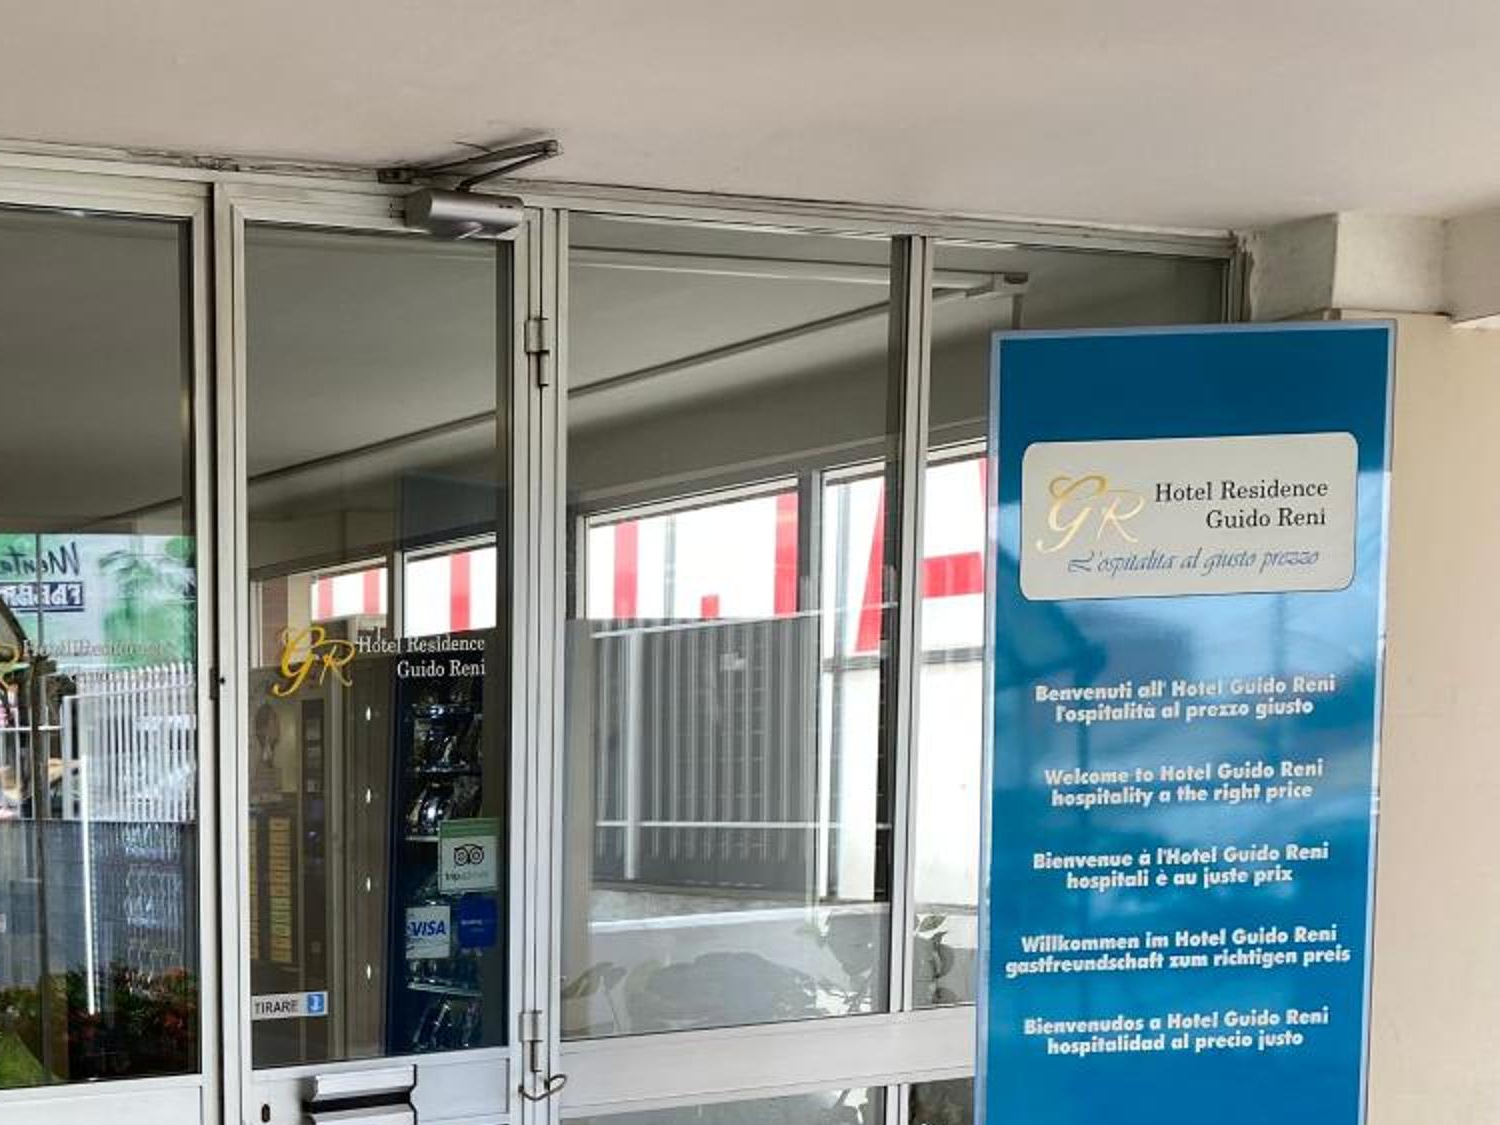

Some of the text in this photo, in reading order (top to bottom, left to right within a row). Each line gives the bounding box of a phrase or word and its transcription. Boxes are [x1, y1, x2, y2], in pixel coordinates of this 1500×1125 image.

[1155, 480, 1328, 503] Hotel Residence
[1205, 507, 1327, 530] Guido Reni
[1179, 547, 1202, 569] al
[1203, 550, 1257, 576] giusto
[1259, 551, 1319, 574] prezzo
[358, 636, 485, 653] Hotel Residence
[397, 658, 485, 677] Guido Reni
[1035, 680, 1132, 702] Benvenuti
[1171, 679, 1222, 697] Hotel
[1231, 677, 1286, 695] Guido
[1293, 674, 1336, 693] Reni
[1161, 700, 1180, 719] al
[1186, 703, 1249, 722] prezzo
[1255, 698, 1314, 719] giusto
[1044, 758, 1324, 786] Welcome to Hotel Guido Reni
[1051, 782, 1313, 810] hospitality a the right price
[1033, 851, 1133, 870] Bienvenue
[1157, 847, 1217, 865] l'Hotel
[1224, 845, 1280, 863] Guido
[1286, 842, 1329, 860] Reni
[1067, 870, 1150, 893] hospitali
[1174, 872, 1197, 886] au
[1203, 867, 1248, 888] juste
[1254, 865, 1293, 886] prix
[410, 920, 447, 937] VISA
[1021, 923, 1337, 953] Willkommen im Hotel Guido Reni
[1005, 944, 1351, 978] gastfreundschaft zum richtigen preis
[254, 1000, 299, 1014] TIRARE
[1024, 1006, 1329, 1035] Bienvenudos a Hotel Guido Reni
[1047, 1030, 1304, 1056] hospitalidad al precio justo
